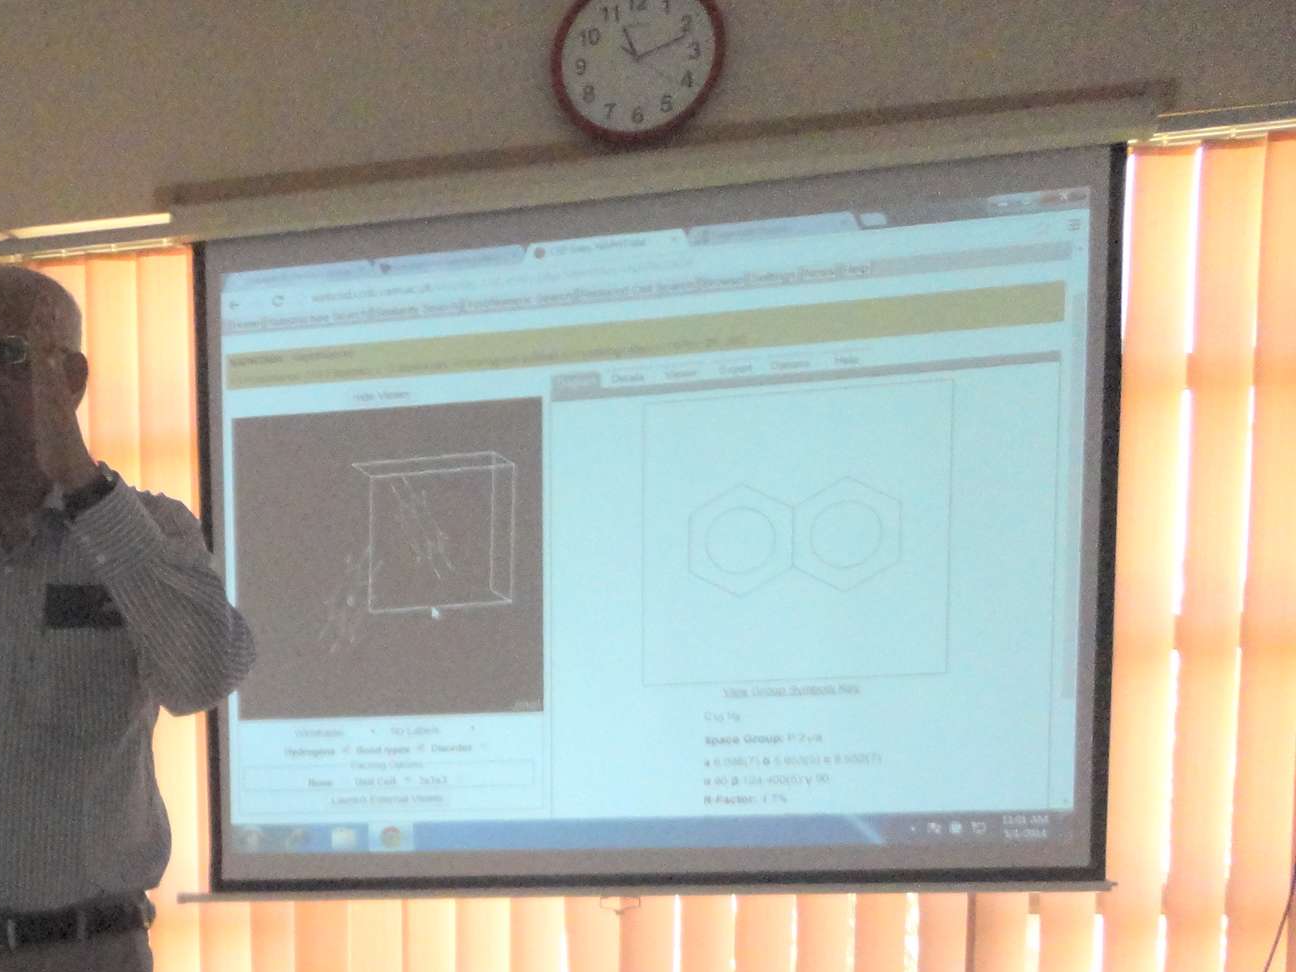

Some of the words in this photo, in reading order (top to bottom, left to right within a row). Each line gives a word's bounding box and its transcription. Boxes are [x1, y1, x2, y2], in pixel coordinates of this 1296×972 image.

[602, 5, 620, 23] 11
[680, 14, 693, 32] 2
[579, 27, 601, 46] 10
[688, 40, 701, 60] 3
[575, 58, 586, 75] 9
[680, 70, 693, 88] 4
[582, 85, 595, 103] 8
[604, 103, 616, 120] 7
[660, 94, 673, 113] 5
[631, 106, 644, 124] 6
